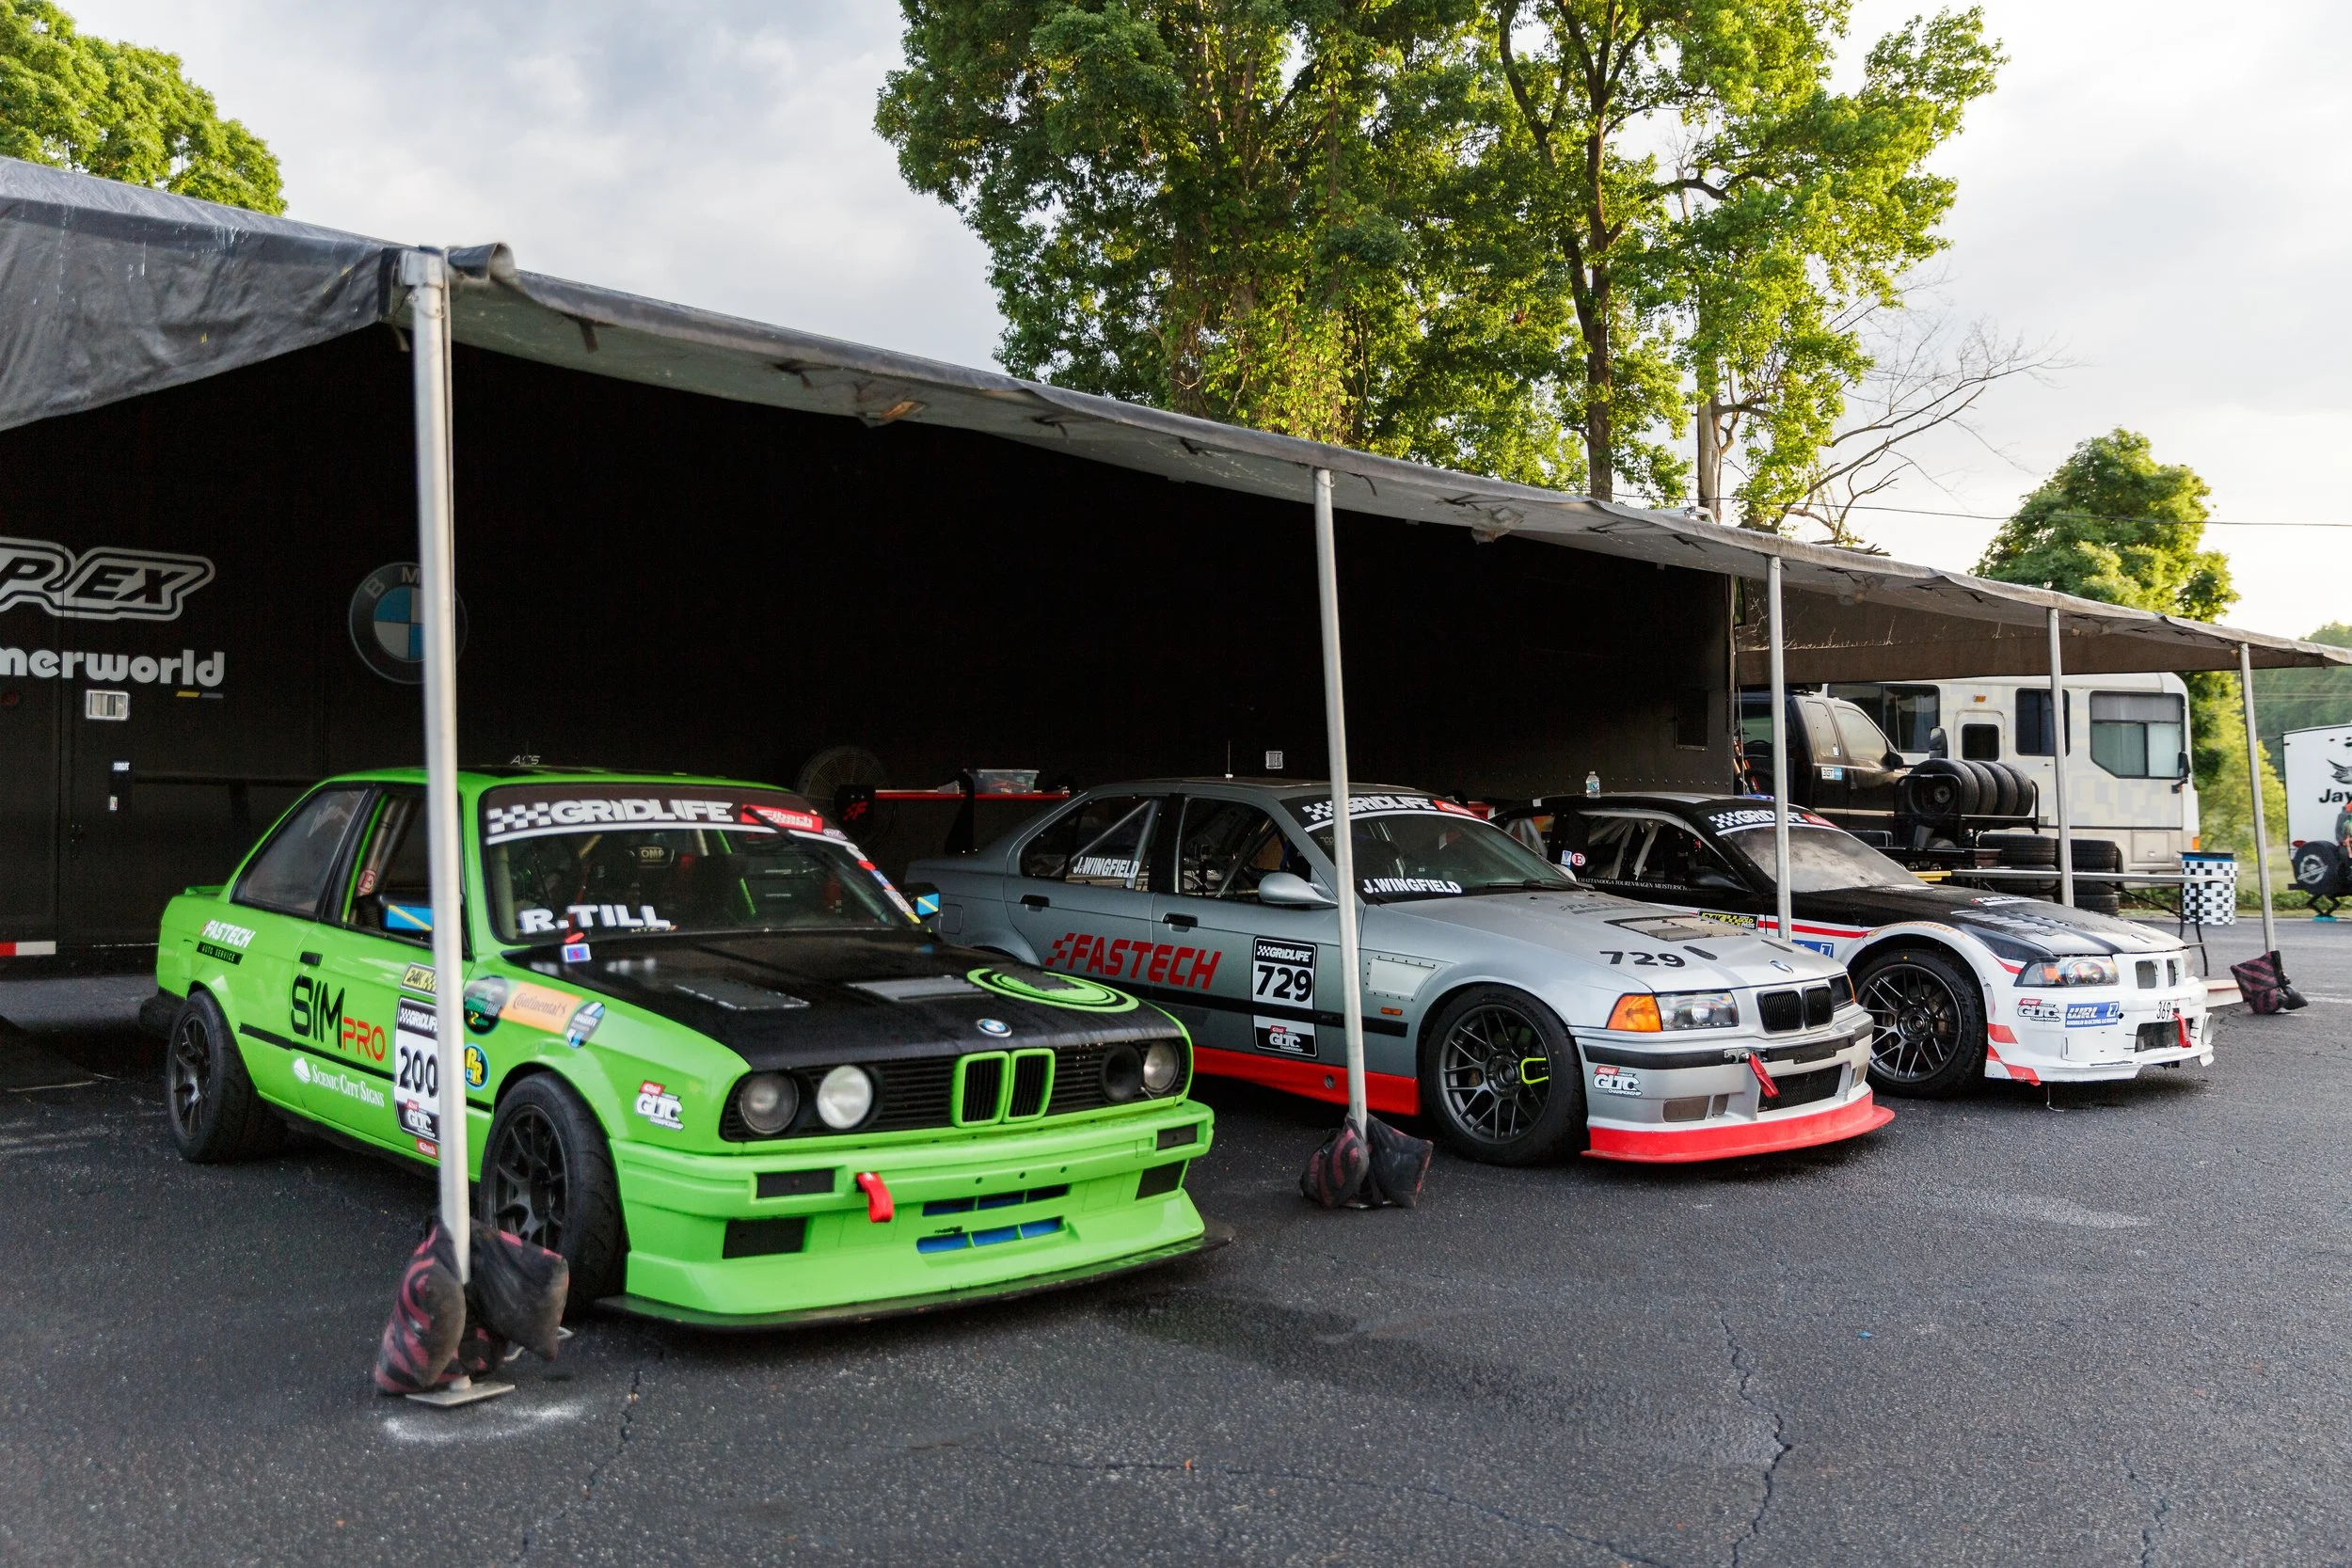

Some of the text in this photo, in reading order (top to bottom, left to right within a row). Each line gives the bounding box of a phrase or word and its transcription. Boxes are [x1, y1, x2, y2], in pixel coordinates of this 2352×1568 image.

[550, 799, 735, 824] GRIDLIFE
[641, 849, 664, 859] OMP
[1073, 856, 1140, 879] J.WINGFIELD
[1363, 879, 1462, 894] J.WINGFIELD
[1578, 877, 1614, 885] CHATTANOOGA
[1615, 879, 1653, 889] TOURENWAGEN
[202, 919, 257, 948] FASTECH
[201, 944, 235, 962] AUTO SERVICE
[1066, 934, 1222, 990] FASTECH
[1269, 946, 1312, 962] GRIDLIFE
[1599, 951, 1686, 968] 729
[1256, 964, 1313, 1003] 729
[291, 974, 386, 1062] SIM PRO
[409, 1009, 439, 1032] GRIDLIF
[2067, 1006, 2098, 1020] WRL
[2156, 1001, 2171, 1021] 369
[399, 1045, 438, 1099] 200
